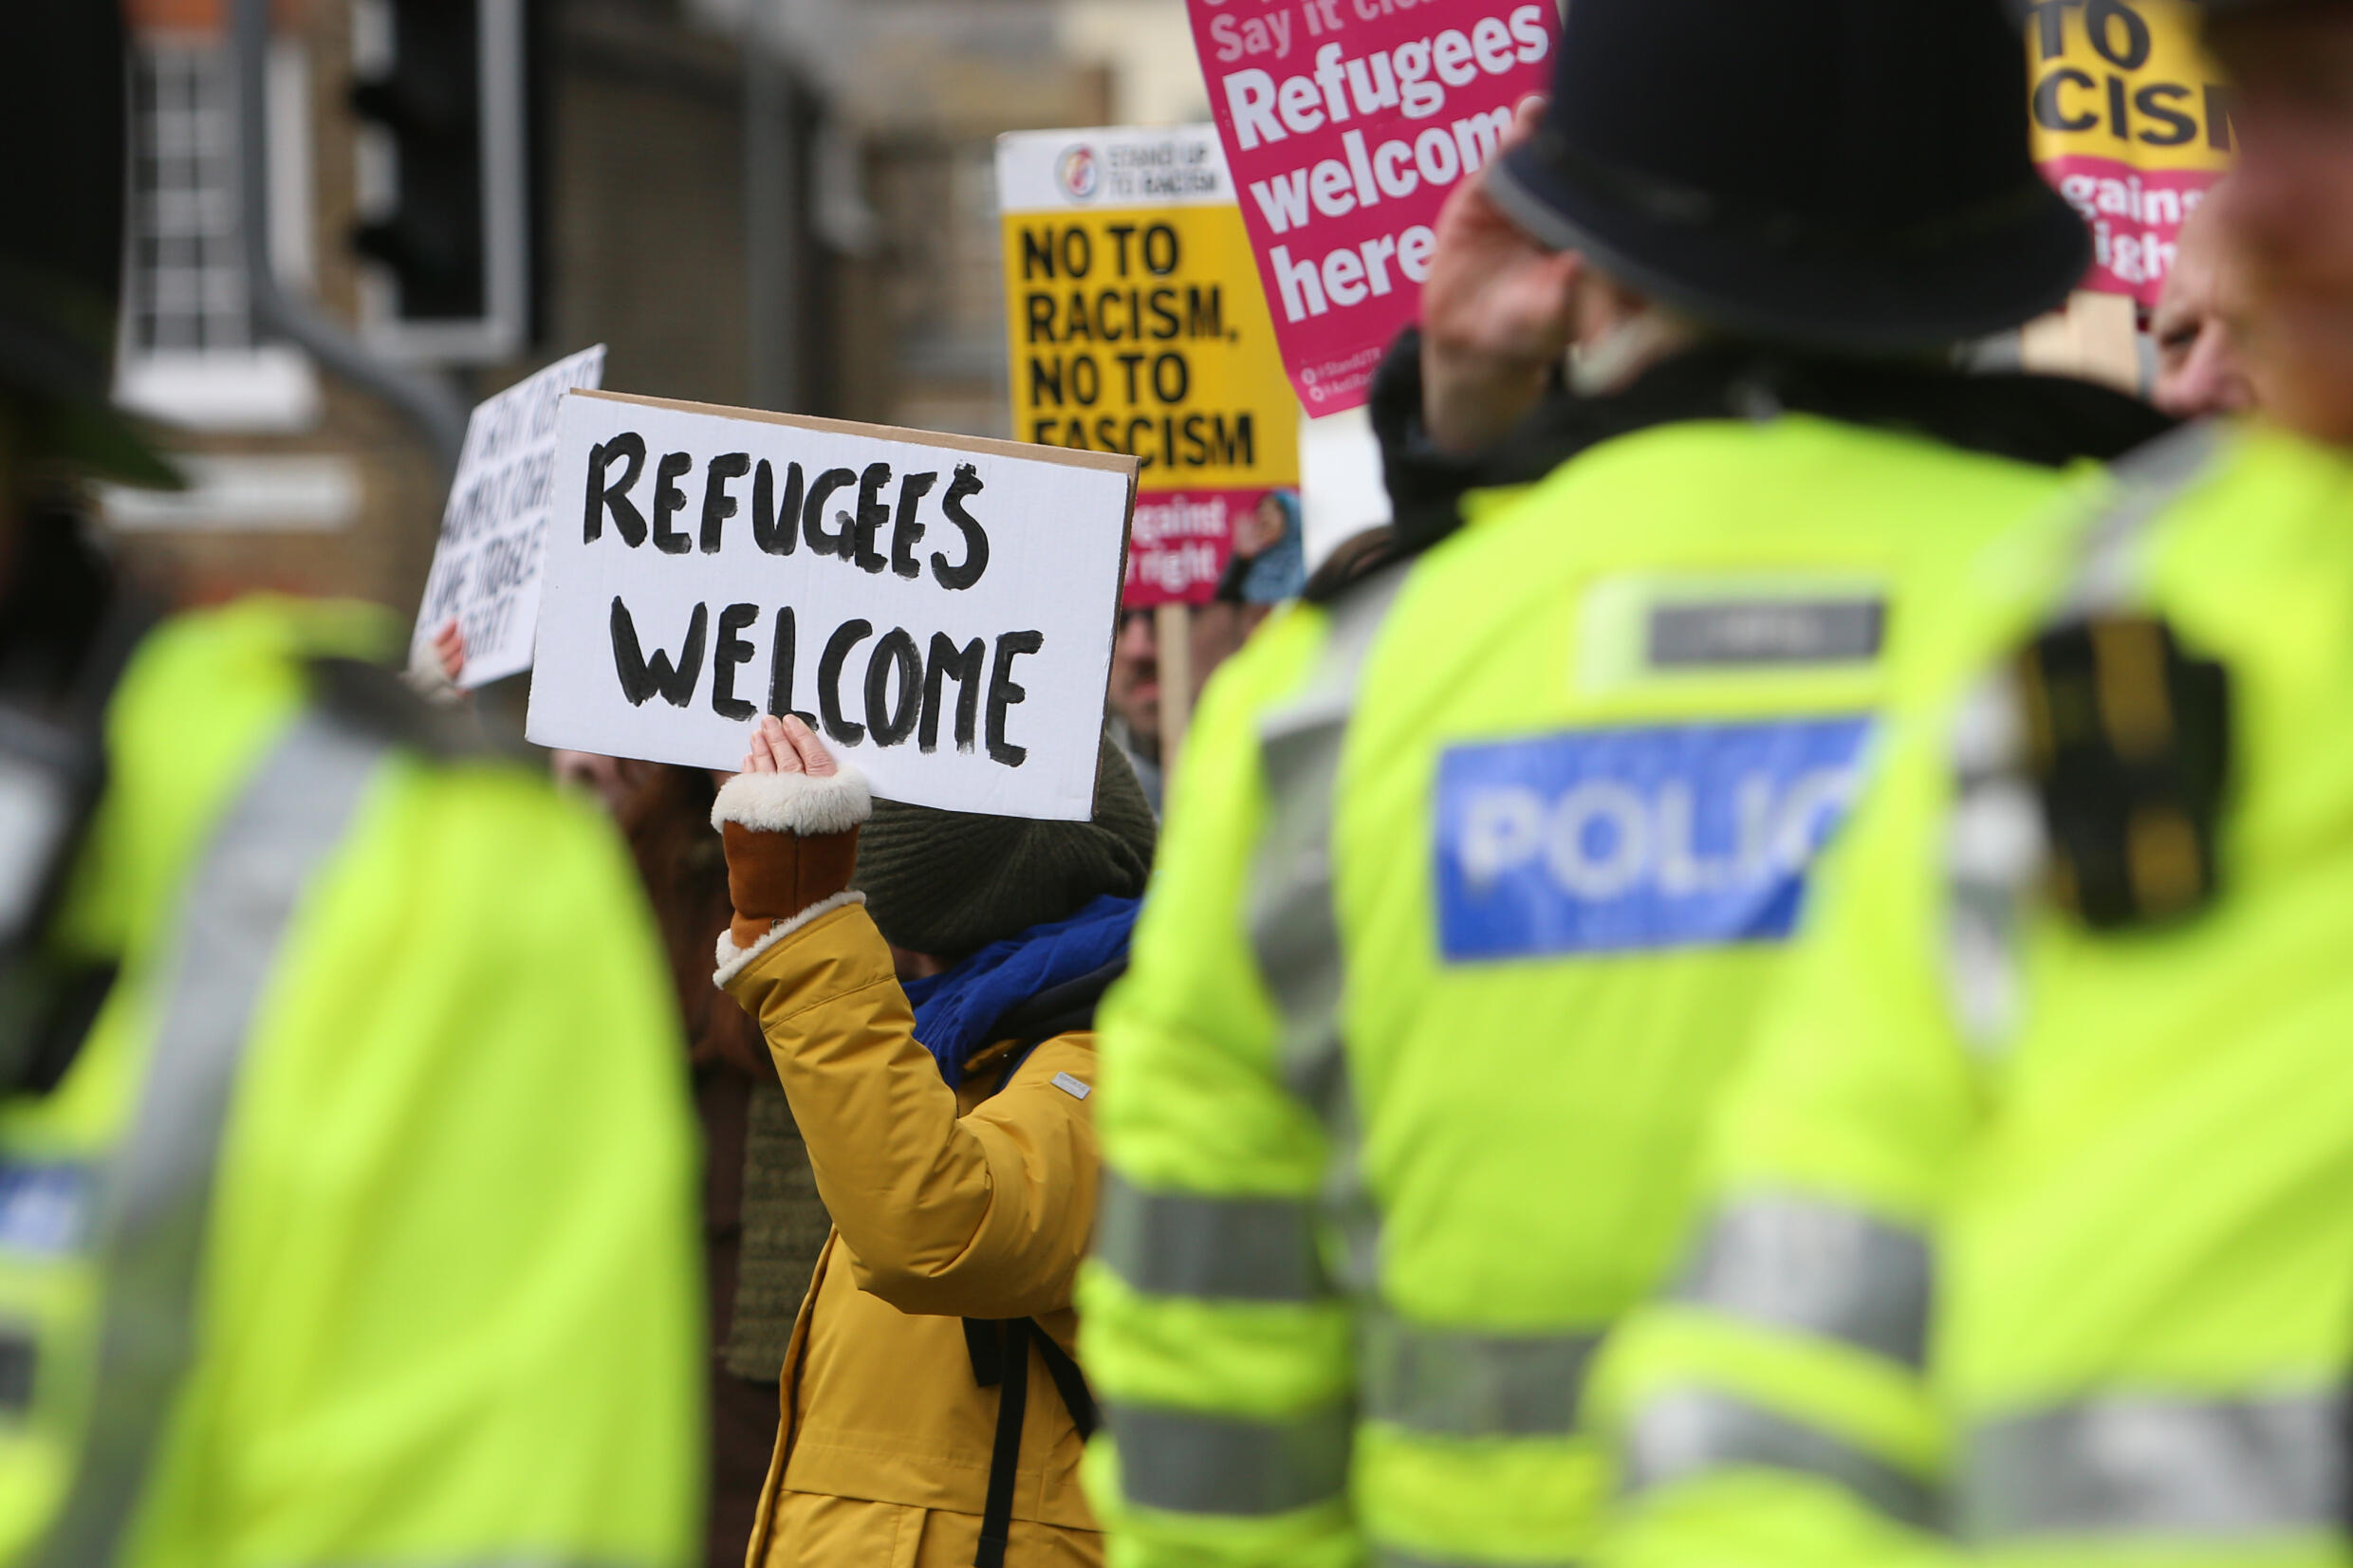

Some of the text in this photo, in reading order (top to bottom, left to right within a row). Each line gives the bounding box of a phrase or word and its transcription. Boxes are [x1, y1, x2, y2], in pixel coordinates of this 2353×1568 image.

[1210, 9, 1290, 62] Say
[1303, 0, 1344, 37] it
[2034, 0, 2151, 72] TO
[1222, 4, 1549, 152] Refugees
[2032, 67, 2232, 153] CIS
[1249, 105, 1516, 235] welcom
[1021, 223, 1180, 280] NO TO
[1269, 224, 1438, 324] here
[2093, 219, 2177, 284] igh
[1026, 286, 1238, 343] RACISM,
[1029, 351, 1191, 407] NO TO
[584, 432, 989, 591] REFUGEES
[1132, 494, 1226, 548] gainst
[1139, 540, 1218, 594] right
[609, 596, 1045, 768] WELCOME
[1455, 762, 1855, 903] POLIC
